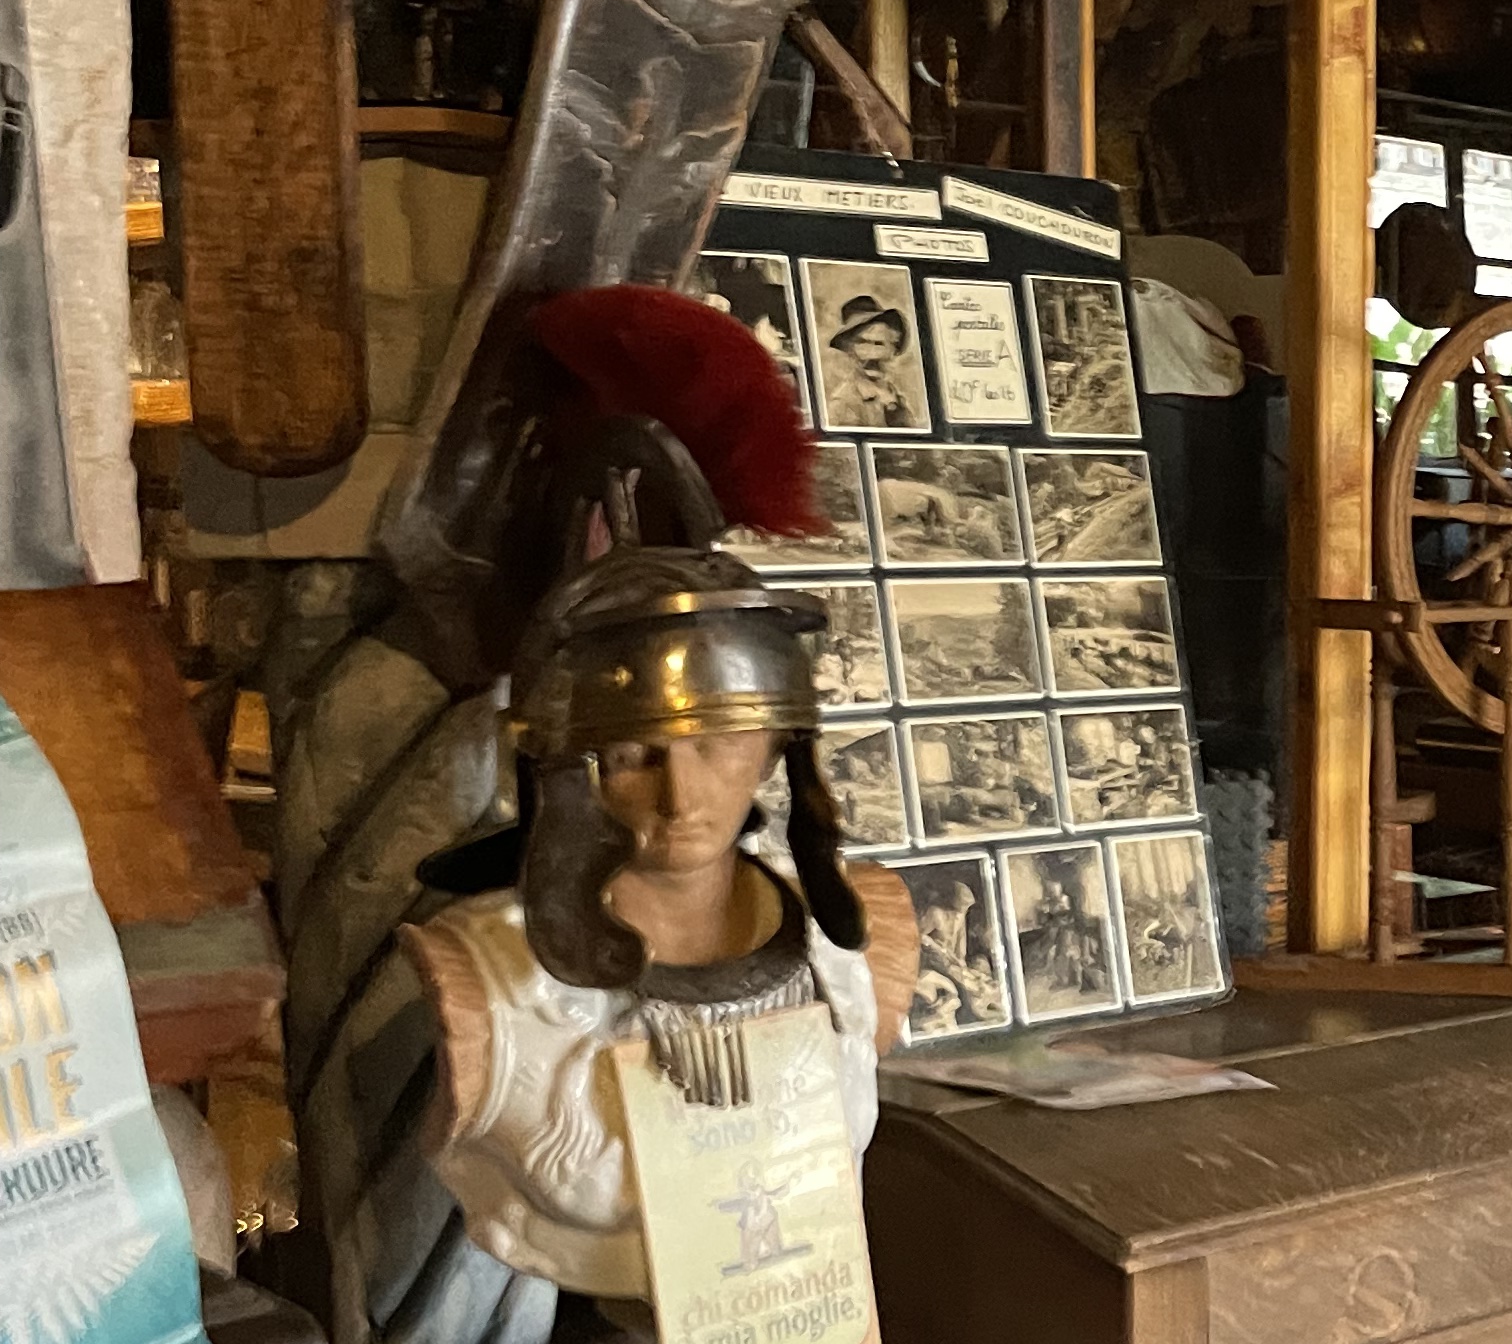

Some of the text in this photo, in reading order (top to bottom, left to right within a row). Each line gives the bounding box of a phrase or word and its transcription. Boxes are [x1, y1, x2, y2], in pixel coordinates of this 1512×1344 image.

[744, 181, 803, 203] VIEUX
[889, 233, 975, 255] PHOTOS
[731, 1259, 852, 1316] comanda
